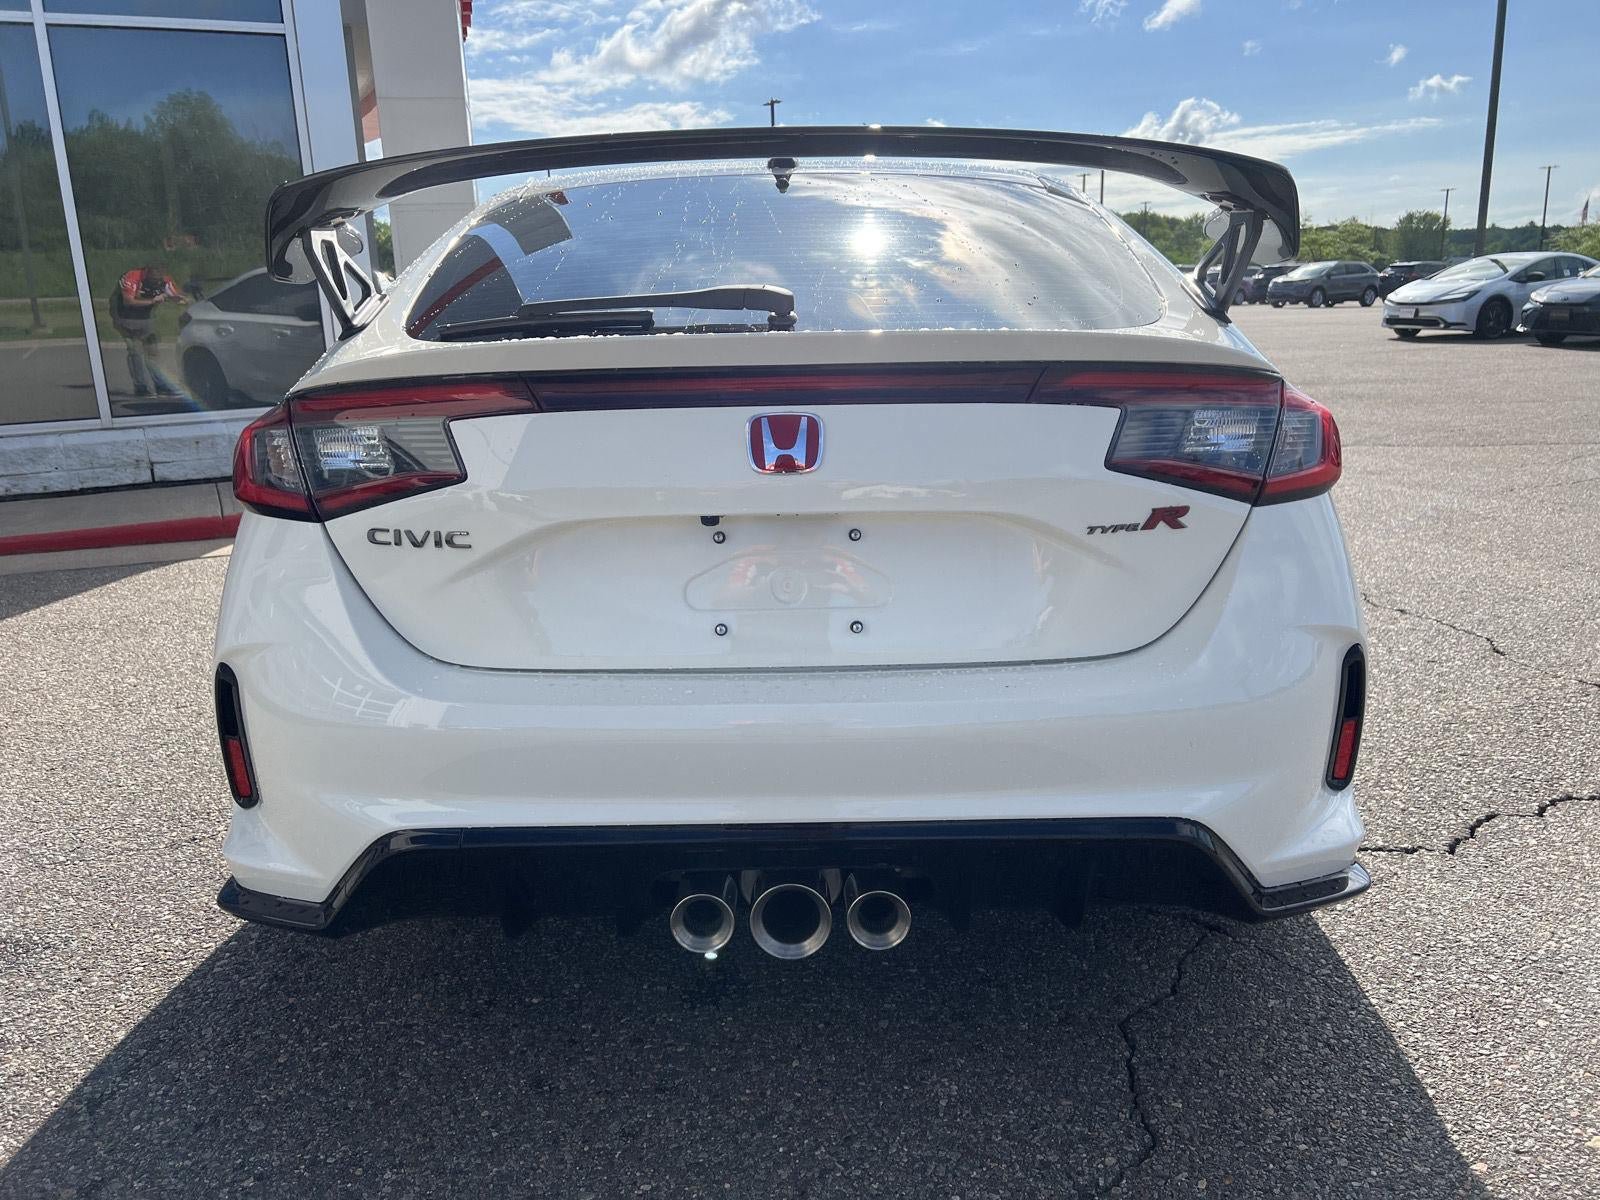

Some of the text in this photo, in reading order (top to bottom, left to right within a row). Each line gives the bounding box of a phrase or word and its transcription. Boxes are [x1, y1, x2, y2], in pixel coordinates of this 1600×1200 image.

[1087, 505, 1190, 535] TYPE R
[367, 528, 472, 549] CIVIC
